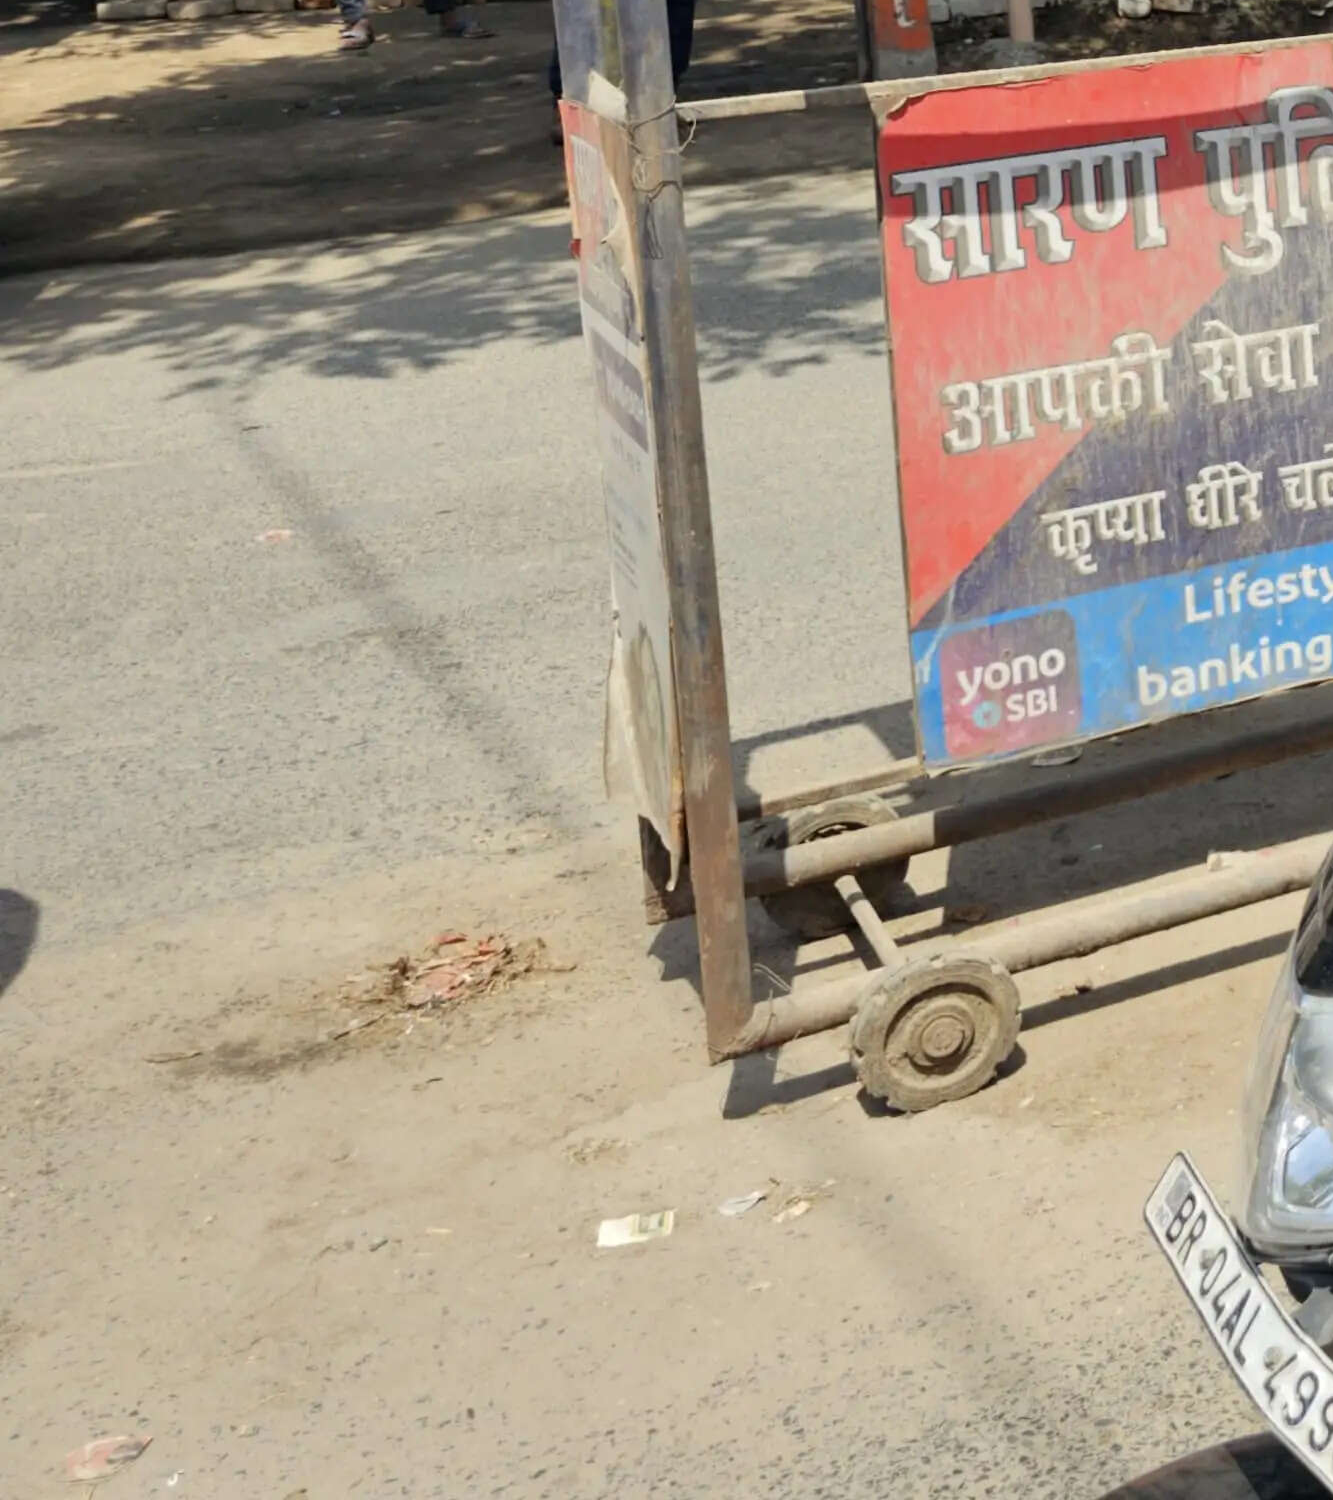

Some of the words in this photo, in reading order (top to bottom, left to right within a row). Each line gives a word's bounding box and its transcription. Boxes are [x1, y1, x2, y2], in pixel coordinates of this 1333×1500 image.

[891, 136, 1168, 285] सारण
[940, 331, 1172, 455] आपकी
[1192, 319, 1320, 404] सेवा
[1040, 489, 1168, 576] कृप्या
[1185, 460, 1265, 531] धीरे
[955, 646, 1067, 706] yono
[1005, 685, 1059, 725] SBI
[1164, 1191, 1208, 1267] BR
